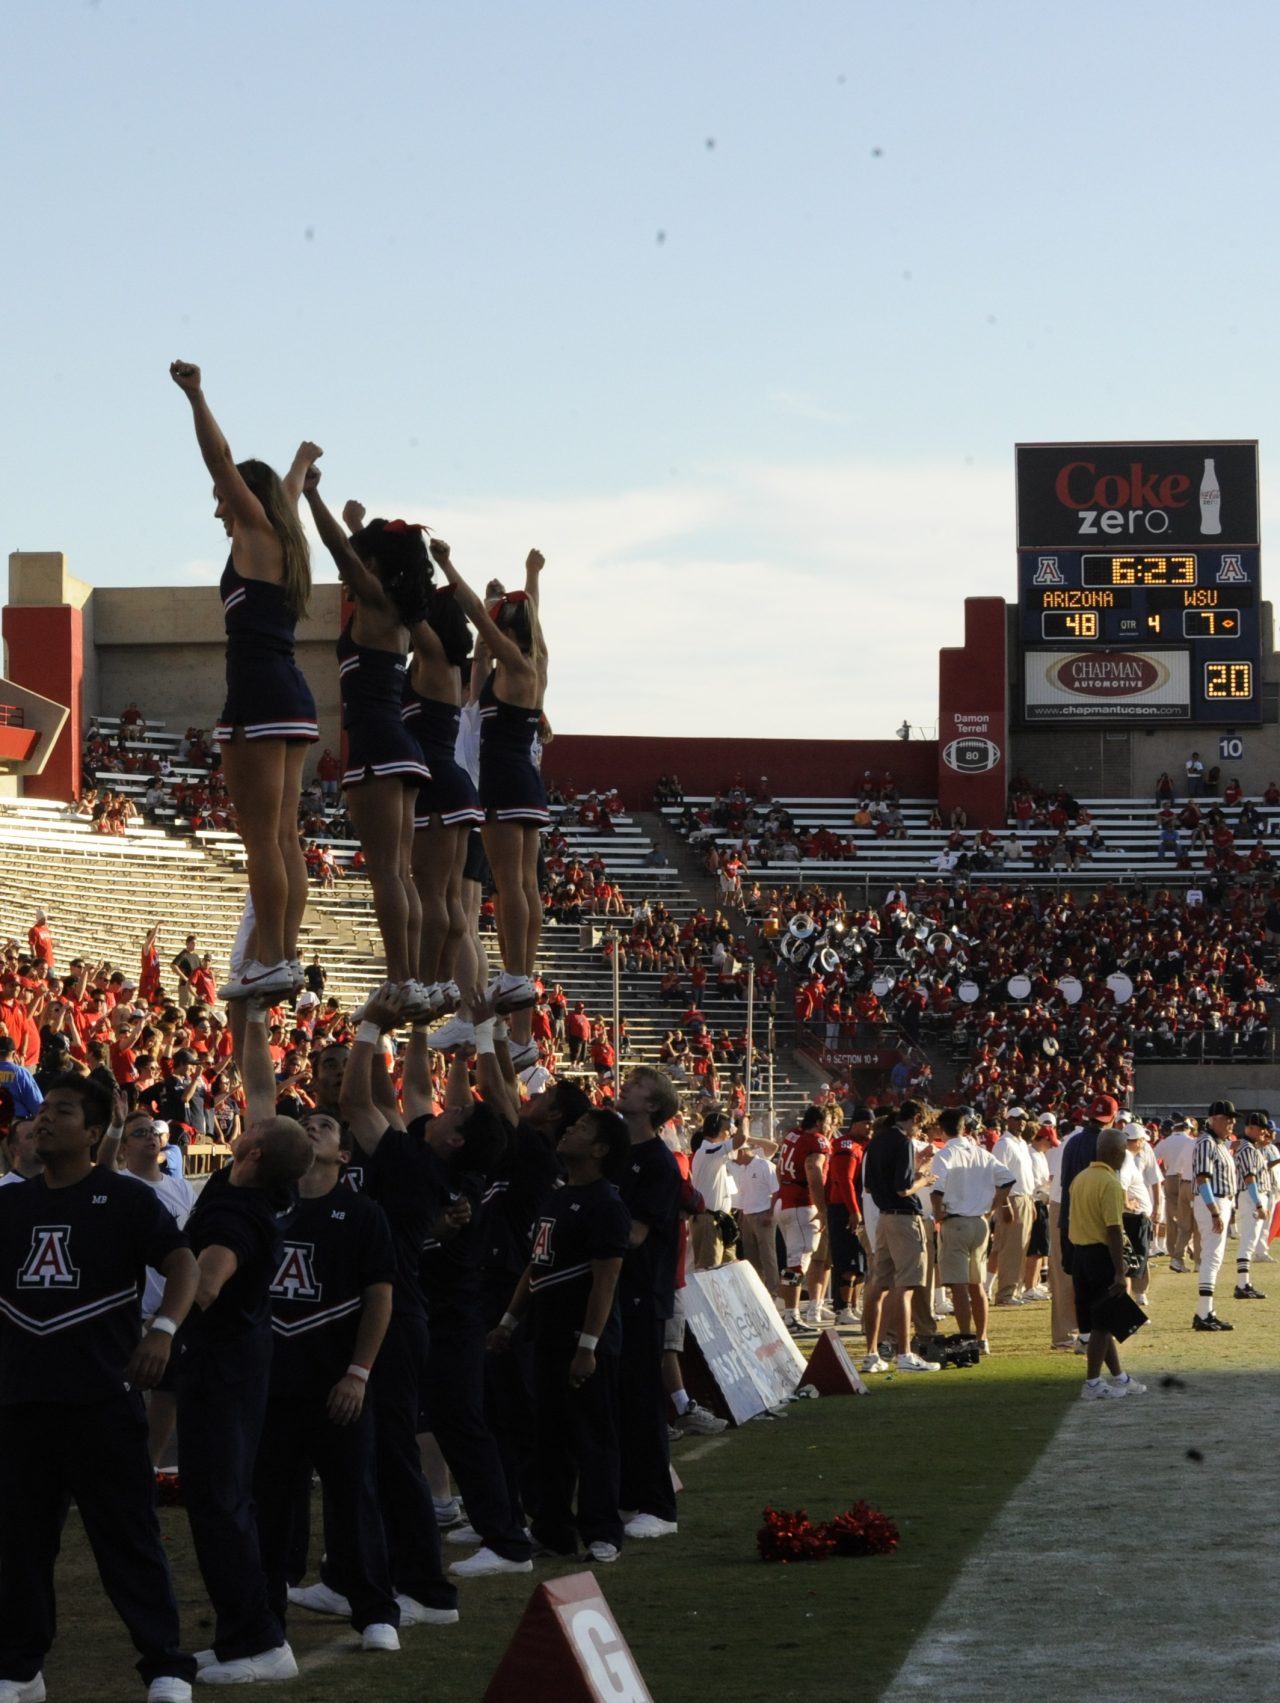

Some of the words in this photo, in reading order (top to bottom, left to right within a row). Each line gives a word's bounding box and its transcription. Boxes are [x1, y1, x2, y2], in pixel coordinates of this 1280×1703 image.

[1055, 461, 1191, 510] Coke
[1078, 510, 1169, 535] zero
[1112, 557, 1194, 584] 6:23
[1043, 591, 1114, 608] ARIZONA
[1184, 590, 1218, 606] WSU
[1066, 614, 1096, 636] 48
[1148, 614, 1160, 632] 4
[1201, 612, 1215, 634] 7
[1072, 661, 1143, 679] CHAPMAN
[1074, 680, 1143, 688] AUTOMOTIVE
[1208, 665, 1249, 697] 20
[954, 713, 990, 723] Damon
[1034, 704, 1182, 717] www.chapmantucson.com
[956, 724, 987, 733] Terrell
[966, 752, 979, 760] 80
[1220, 739, 1242, 757] 10
[834, 1054, 862, 1064] SECTION
[17, 1225, 80, 1289] A
[269, 1241, 322, 1302] A
